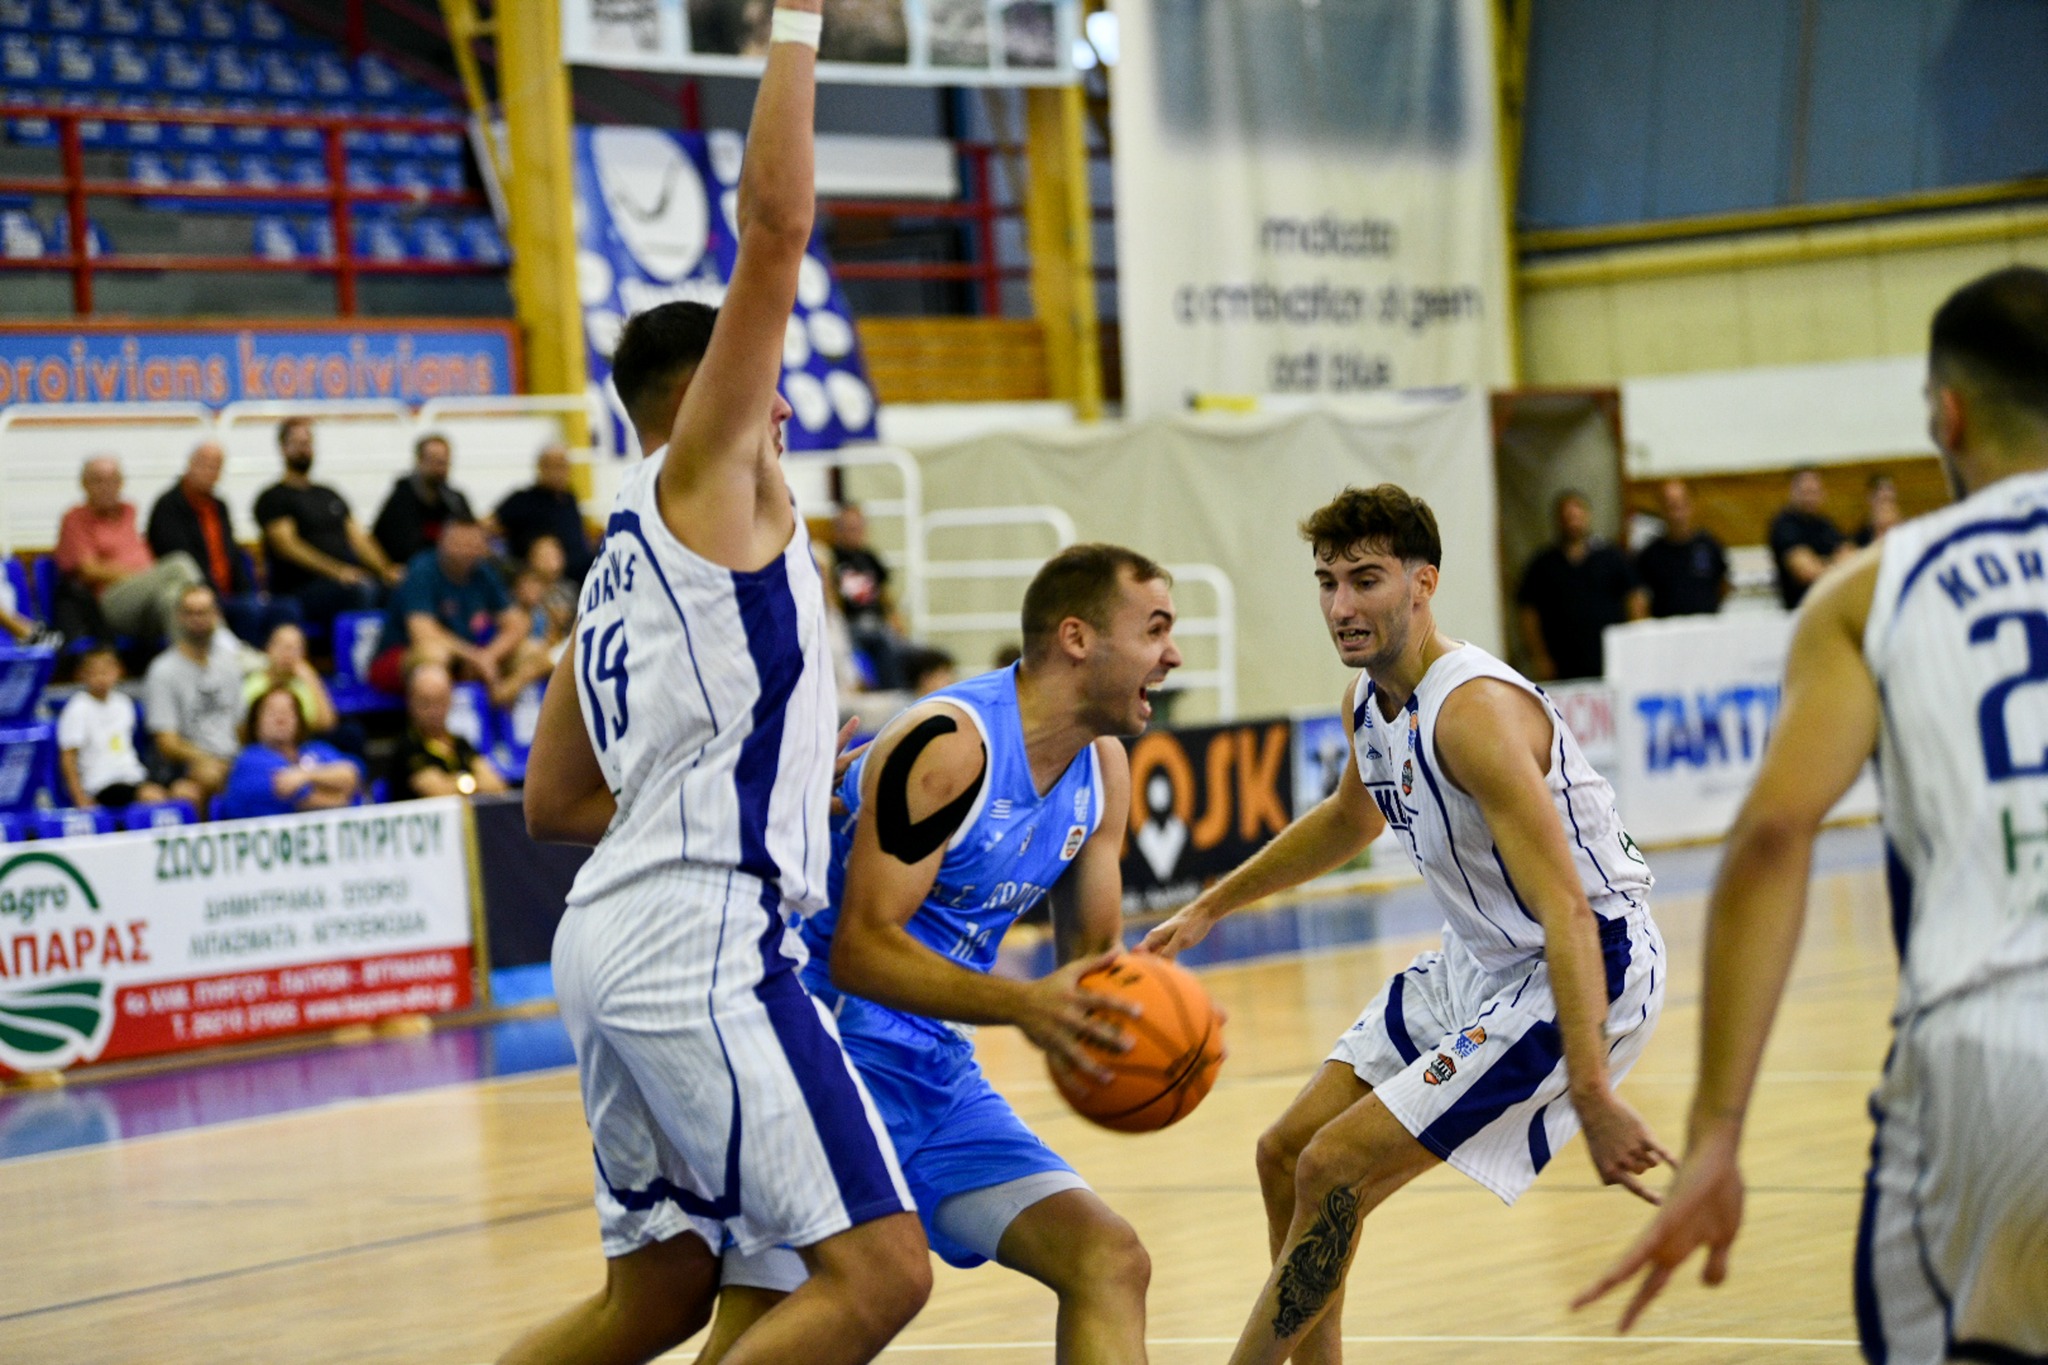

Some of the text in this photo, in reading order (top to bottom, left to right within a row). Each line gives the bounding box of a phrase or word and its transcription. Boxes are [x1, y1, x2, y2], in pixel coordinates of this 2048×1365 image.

[238, 331, 494, 399] koroivians
[581, 617, 629, 752] 19
[1637, 684, 1779, 770] TAKT
[1119, 729, 1291, 860] OSK
[155, 822, 328, 881] ΖΩΟΤΡΟΦΕΣ
[338, 812, 443, 857] ΠΥΡΓΟΥ
[0, 886, 68, 925] agro
